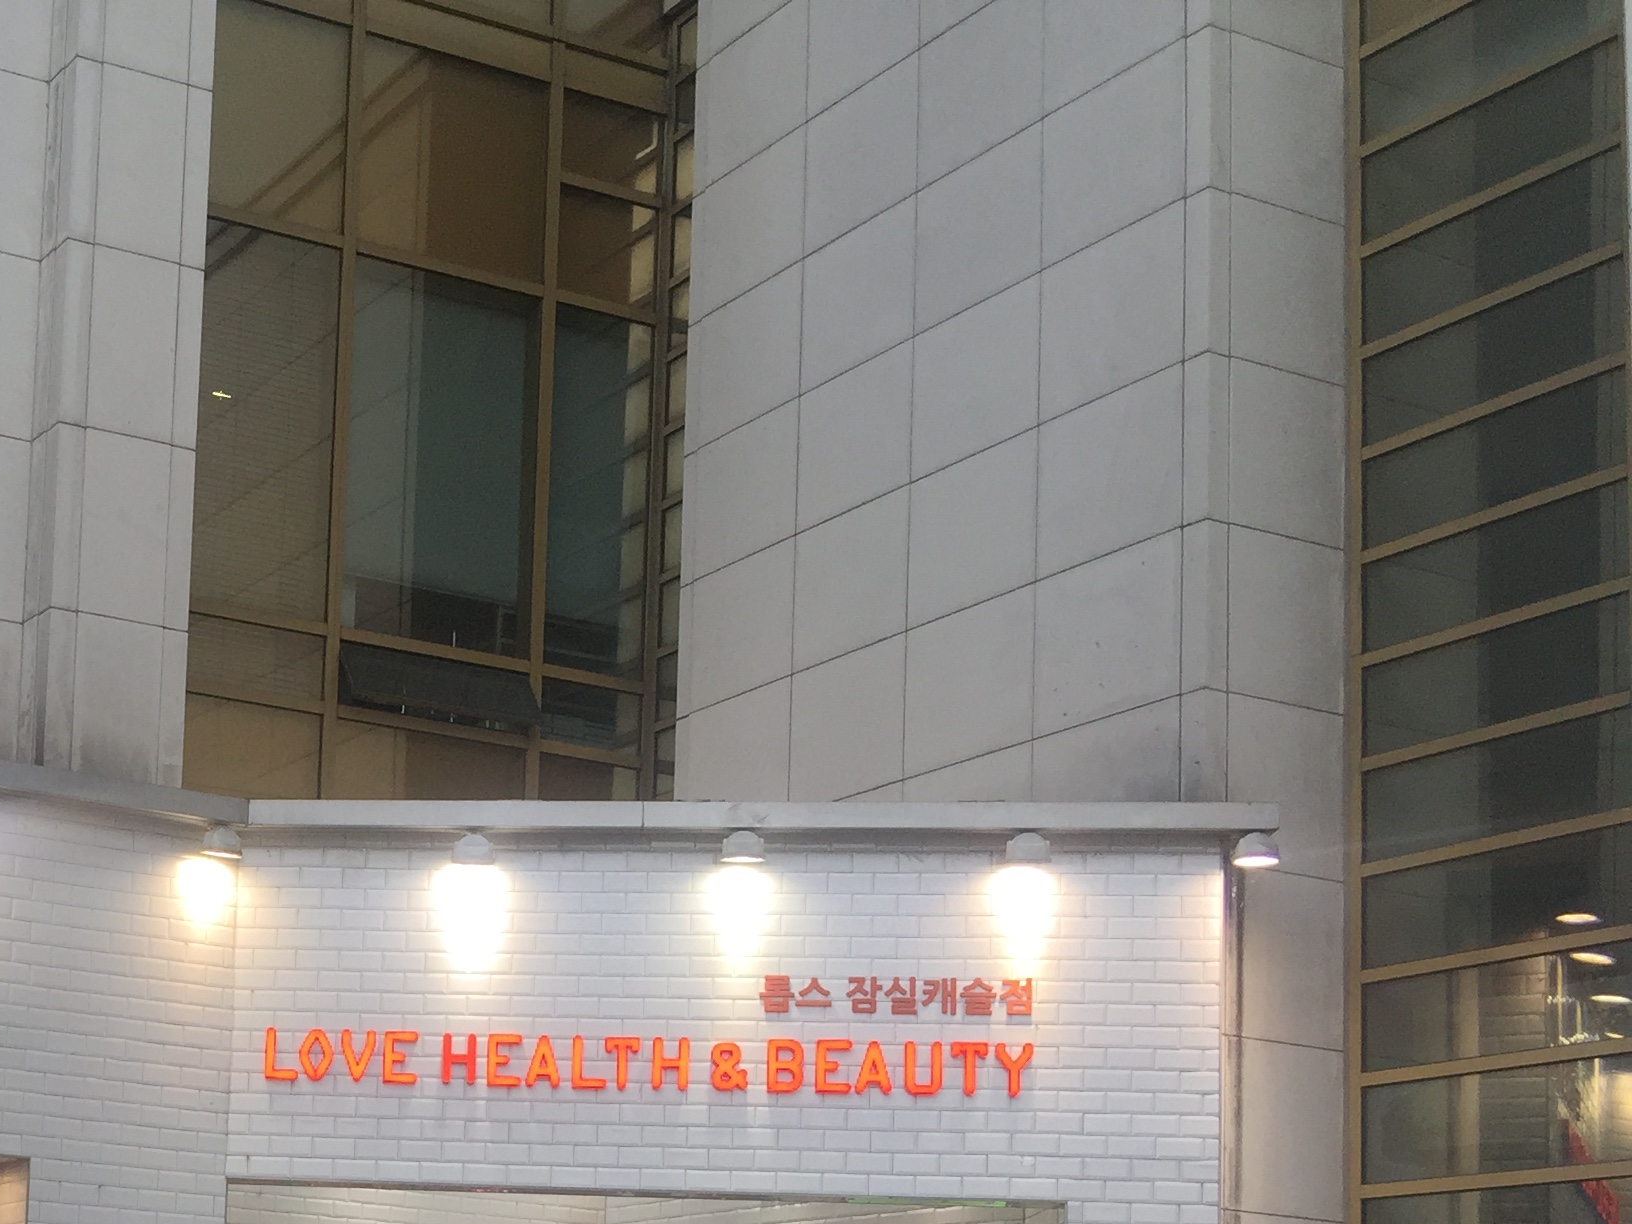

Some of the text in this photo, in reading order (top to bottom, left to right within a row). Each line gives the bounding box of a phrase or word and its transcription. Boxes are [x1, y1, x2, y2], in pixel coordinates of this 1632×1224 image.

[759, 974, 1034, 1017] 롭스 잠실캐슬점
[263, 1026, 1036, 1099] LOVE HEALTH & BEAUTY
